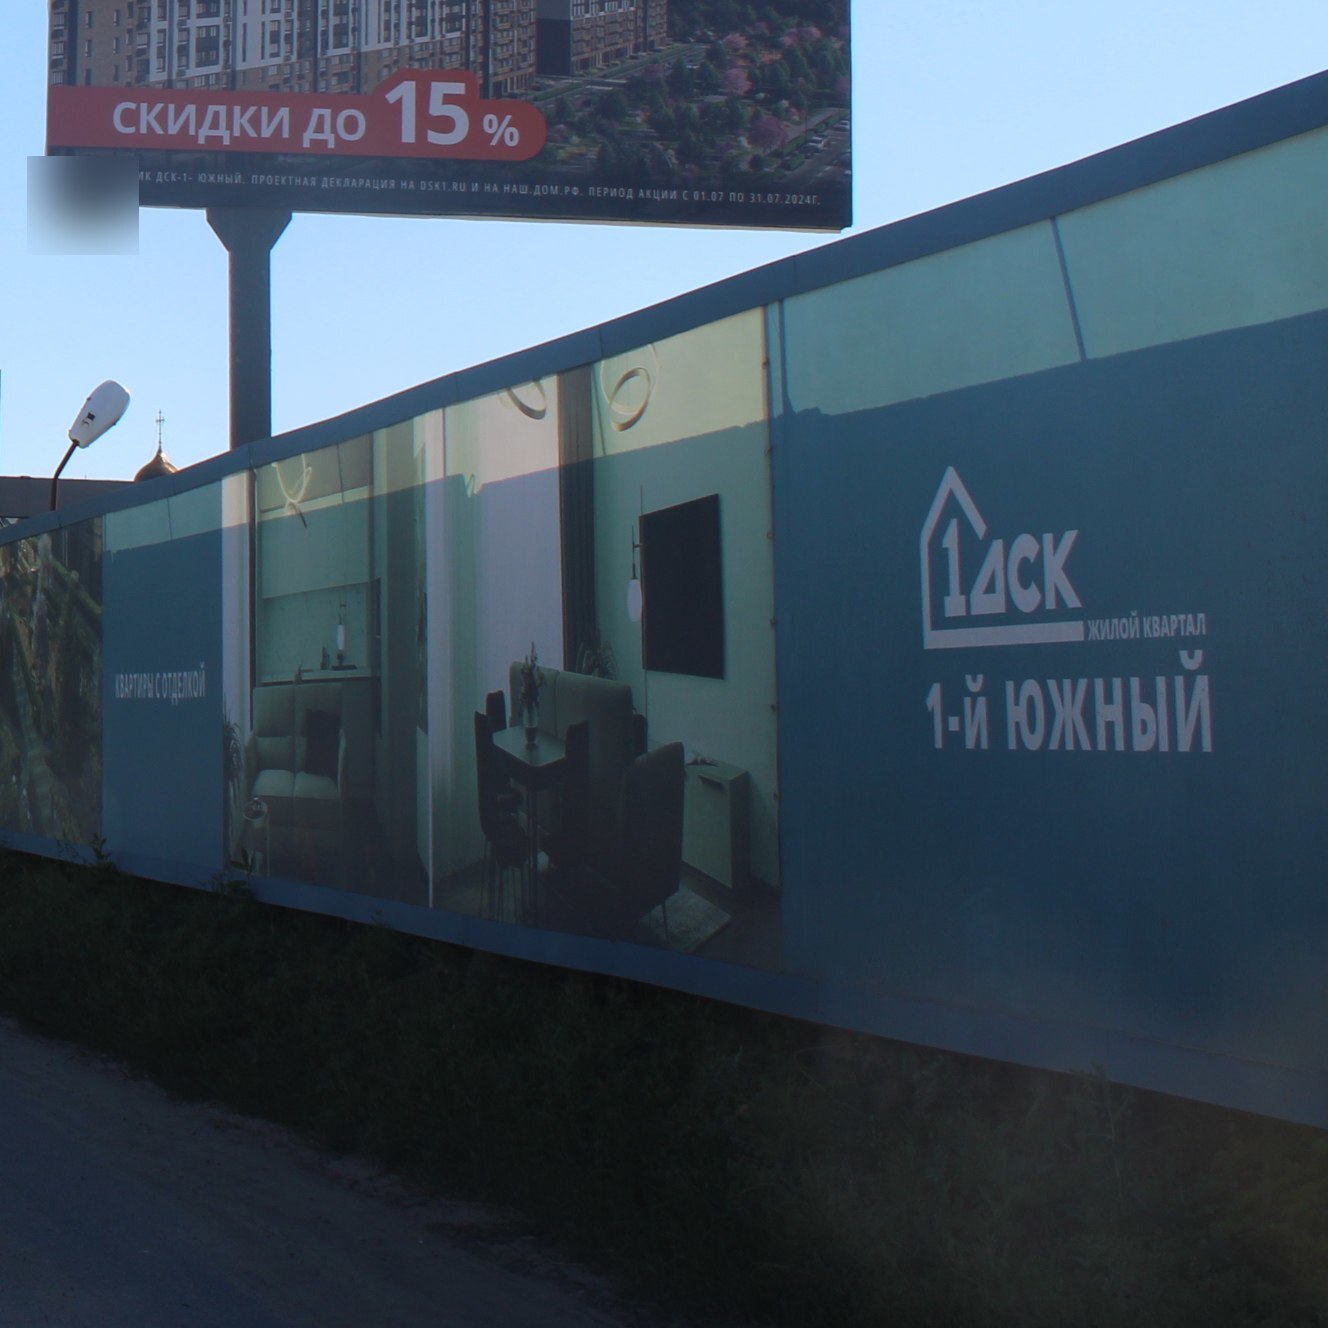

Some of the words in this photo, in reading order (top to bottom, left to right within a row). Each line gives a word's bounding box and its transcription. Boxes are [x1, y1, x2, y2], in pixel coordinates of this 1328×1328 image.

[112, 101, 290, 145] СКИДКИ
[302, 108, 366, 149] ДО
[385, 80, 470, 145] 15
[251, 174, 317, 186] ПРОЕКТНАЯ
[321, 177, 395, 190] ДЕКЛАРАЦИЯ
[400, 179, 415, 190] НА
[419, 180, 466, 192] DSK1.RU
[471, 182, 479, 192] И
[484, 183, 498, 193] НА
[588, 186, 633, 199] ПЕРИОД
[638, 188, 677, 201] АКЦИИ
[682, 190, 689, 201] С
[693, 190, 724, 202] 01.07
[729, 191, 744, 203] ПО
[1087, 610, 1140, 641] ЖИЛОЙ
[1143, 612, 1207, 638] КВАРТАЛ
[925, 674, 989, 750] 1-й
[1005, 649, 1213, 752] ЮЖНЫЙ
